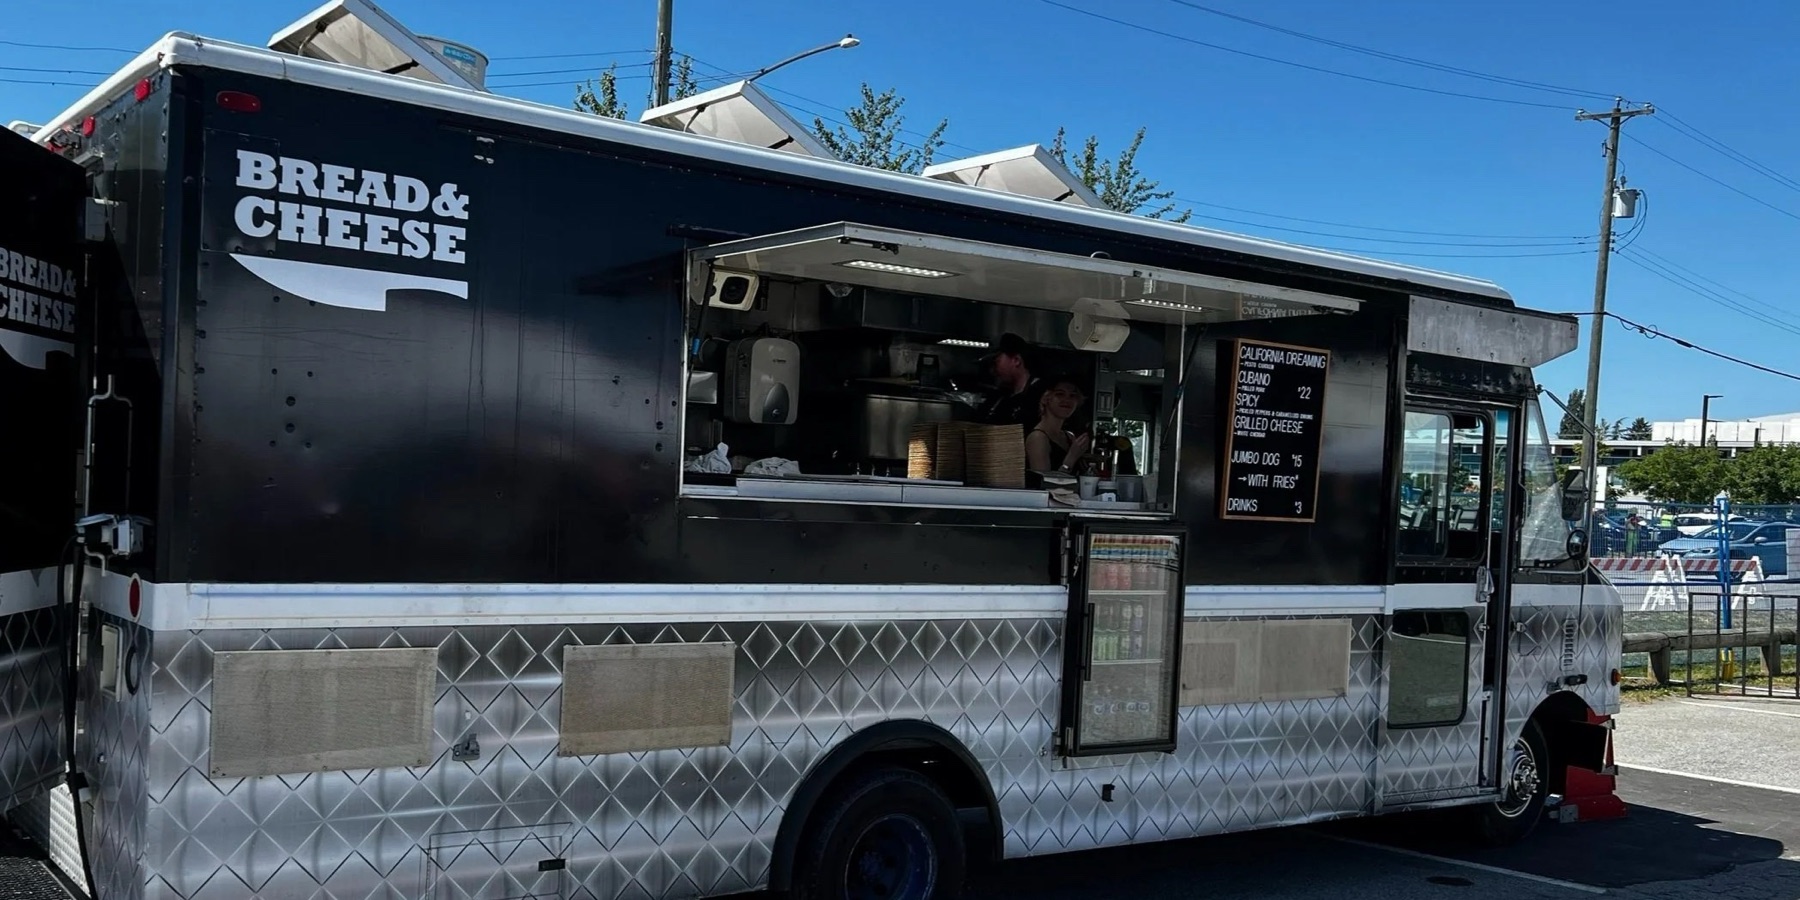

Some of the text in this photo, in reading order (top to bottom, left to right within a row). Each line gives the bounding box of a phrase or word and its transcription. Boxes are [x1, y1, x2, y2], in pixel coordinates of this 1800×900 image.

[235, 149, 469, 220] BREAD&
[234, 196, 467, 264] CHEESE
[1240, 345, 1326, 369] CALIFORNIA DREAMING
[1238, 370, 1271, 386] CUBANO
[1235, 392, 1260, 407] SPICY
[1234, 415, 1304, 434] GRILLED CHEESE
[1231, 450, 1260, 464] JUMBO
[1262, 452, 1280, 466] DOG
[1247, 473, 1269, 487] WITH
[1227, 497, 1258, 512] DRINKS
